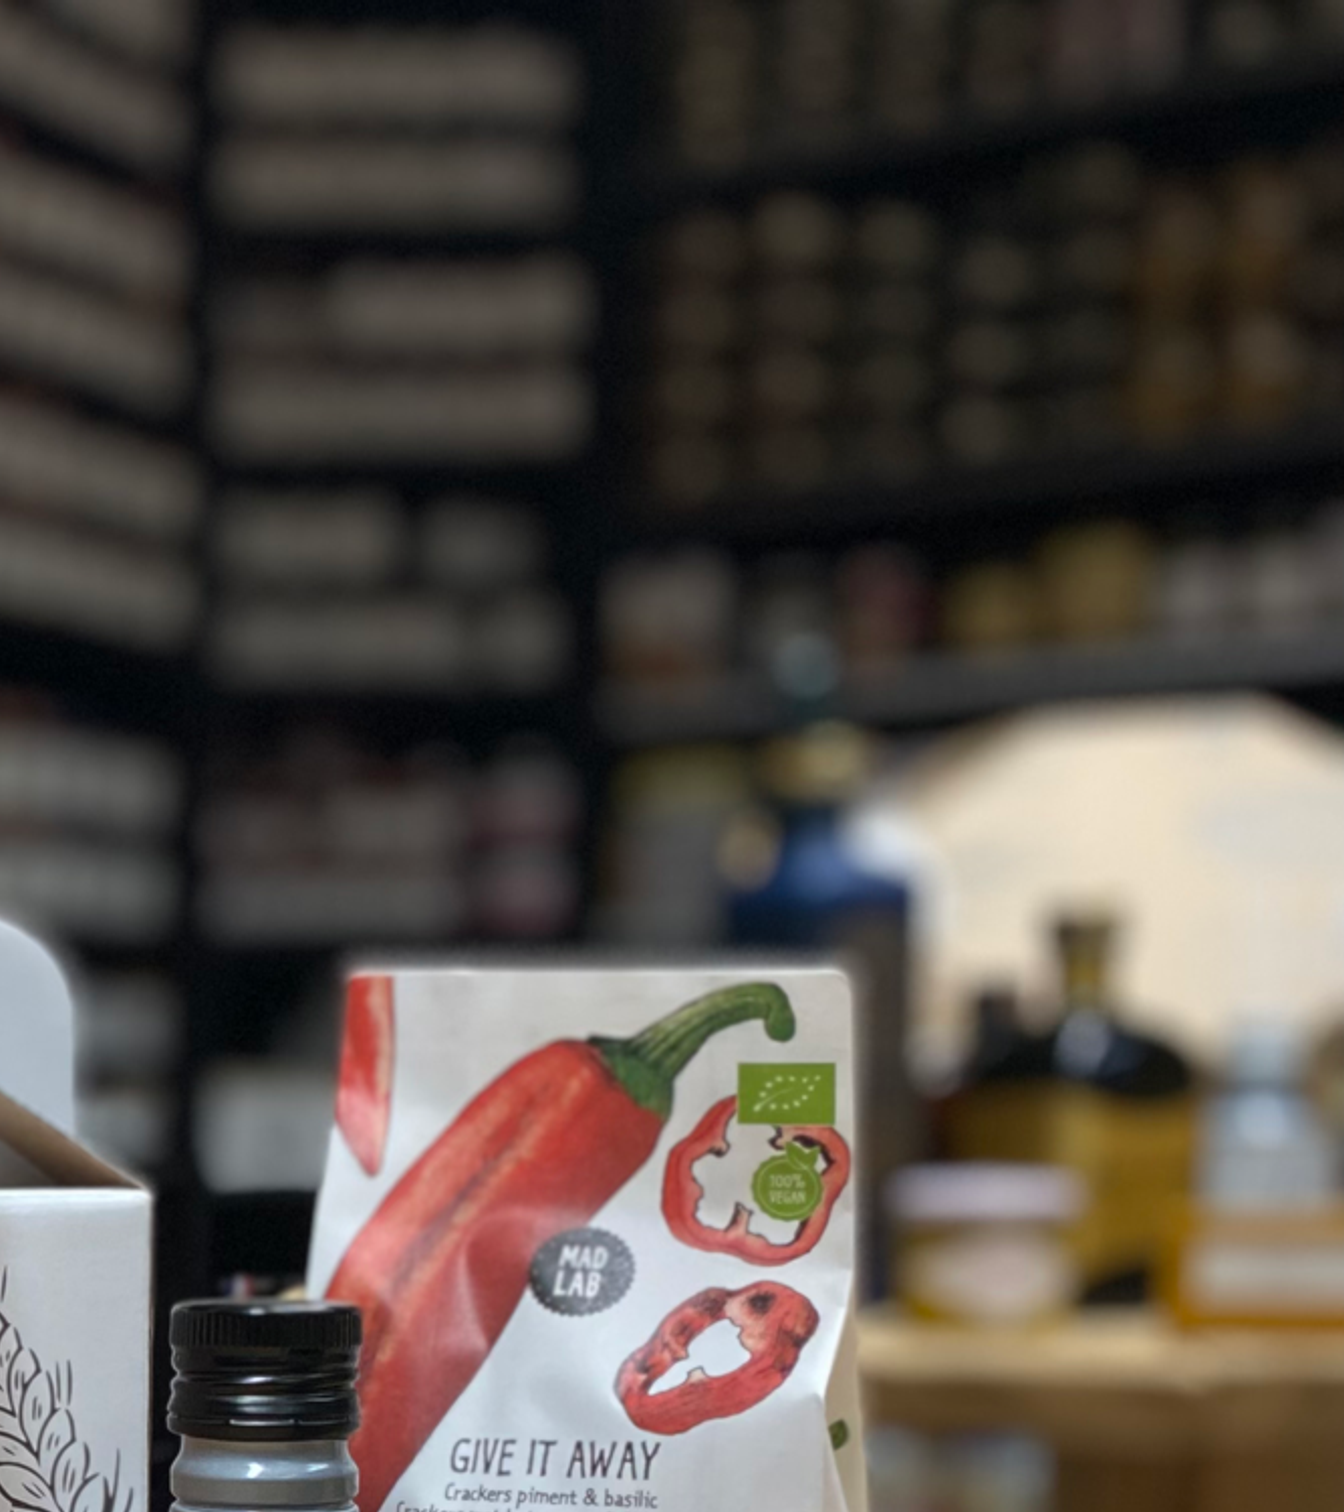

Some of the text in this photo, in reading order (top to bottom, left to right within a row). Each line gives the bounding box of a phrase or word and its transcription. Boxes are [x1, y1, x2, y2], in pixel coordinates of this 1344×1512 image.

[769, 1174, 806, 1189] 100%
[769, 1190, 806, 1204] VEGAN
[558, 1245, 609, 1269] MAD
[553, 1270, 602, 1298] LAB
[450, 1438, 661, 1480] GIVE IT AWAY
[444, 1482, 658, 1509] Crackers piment & basilic
